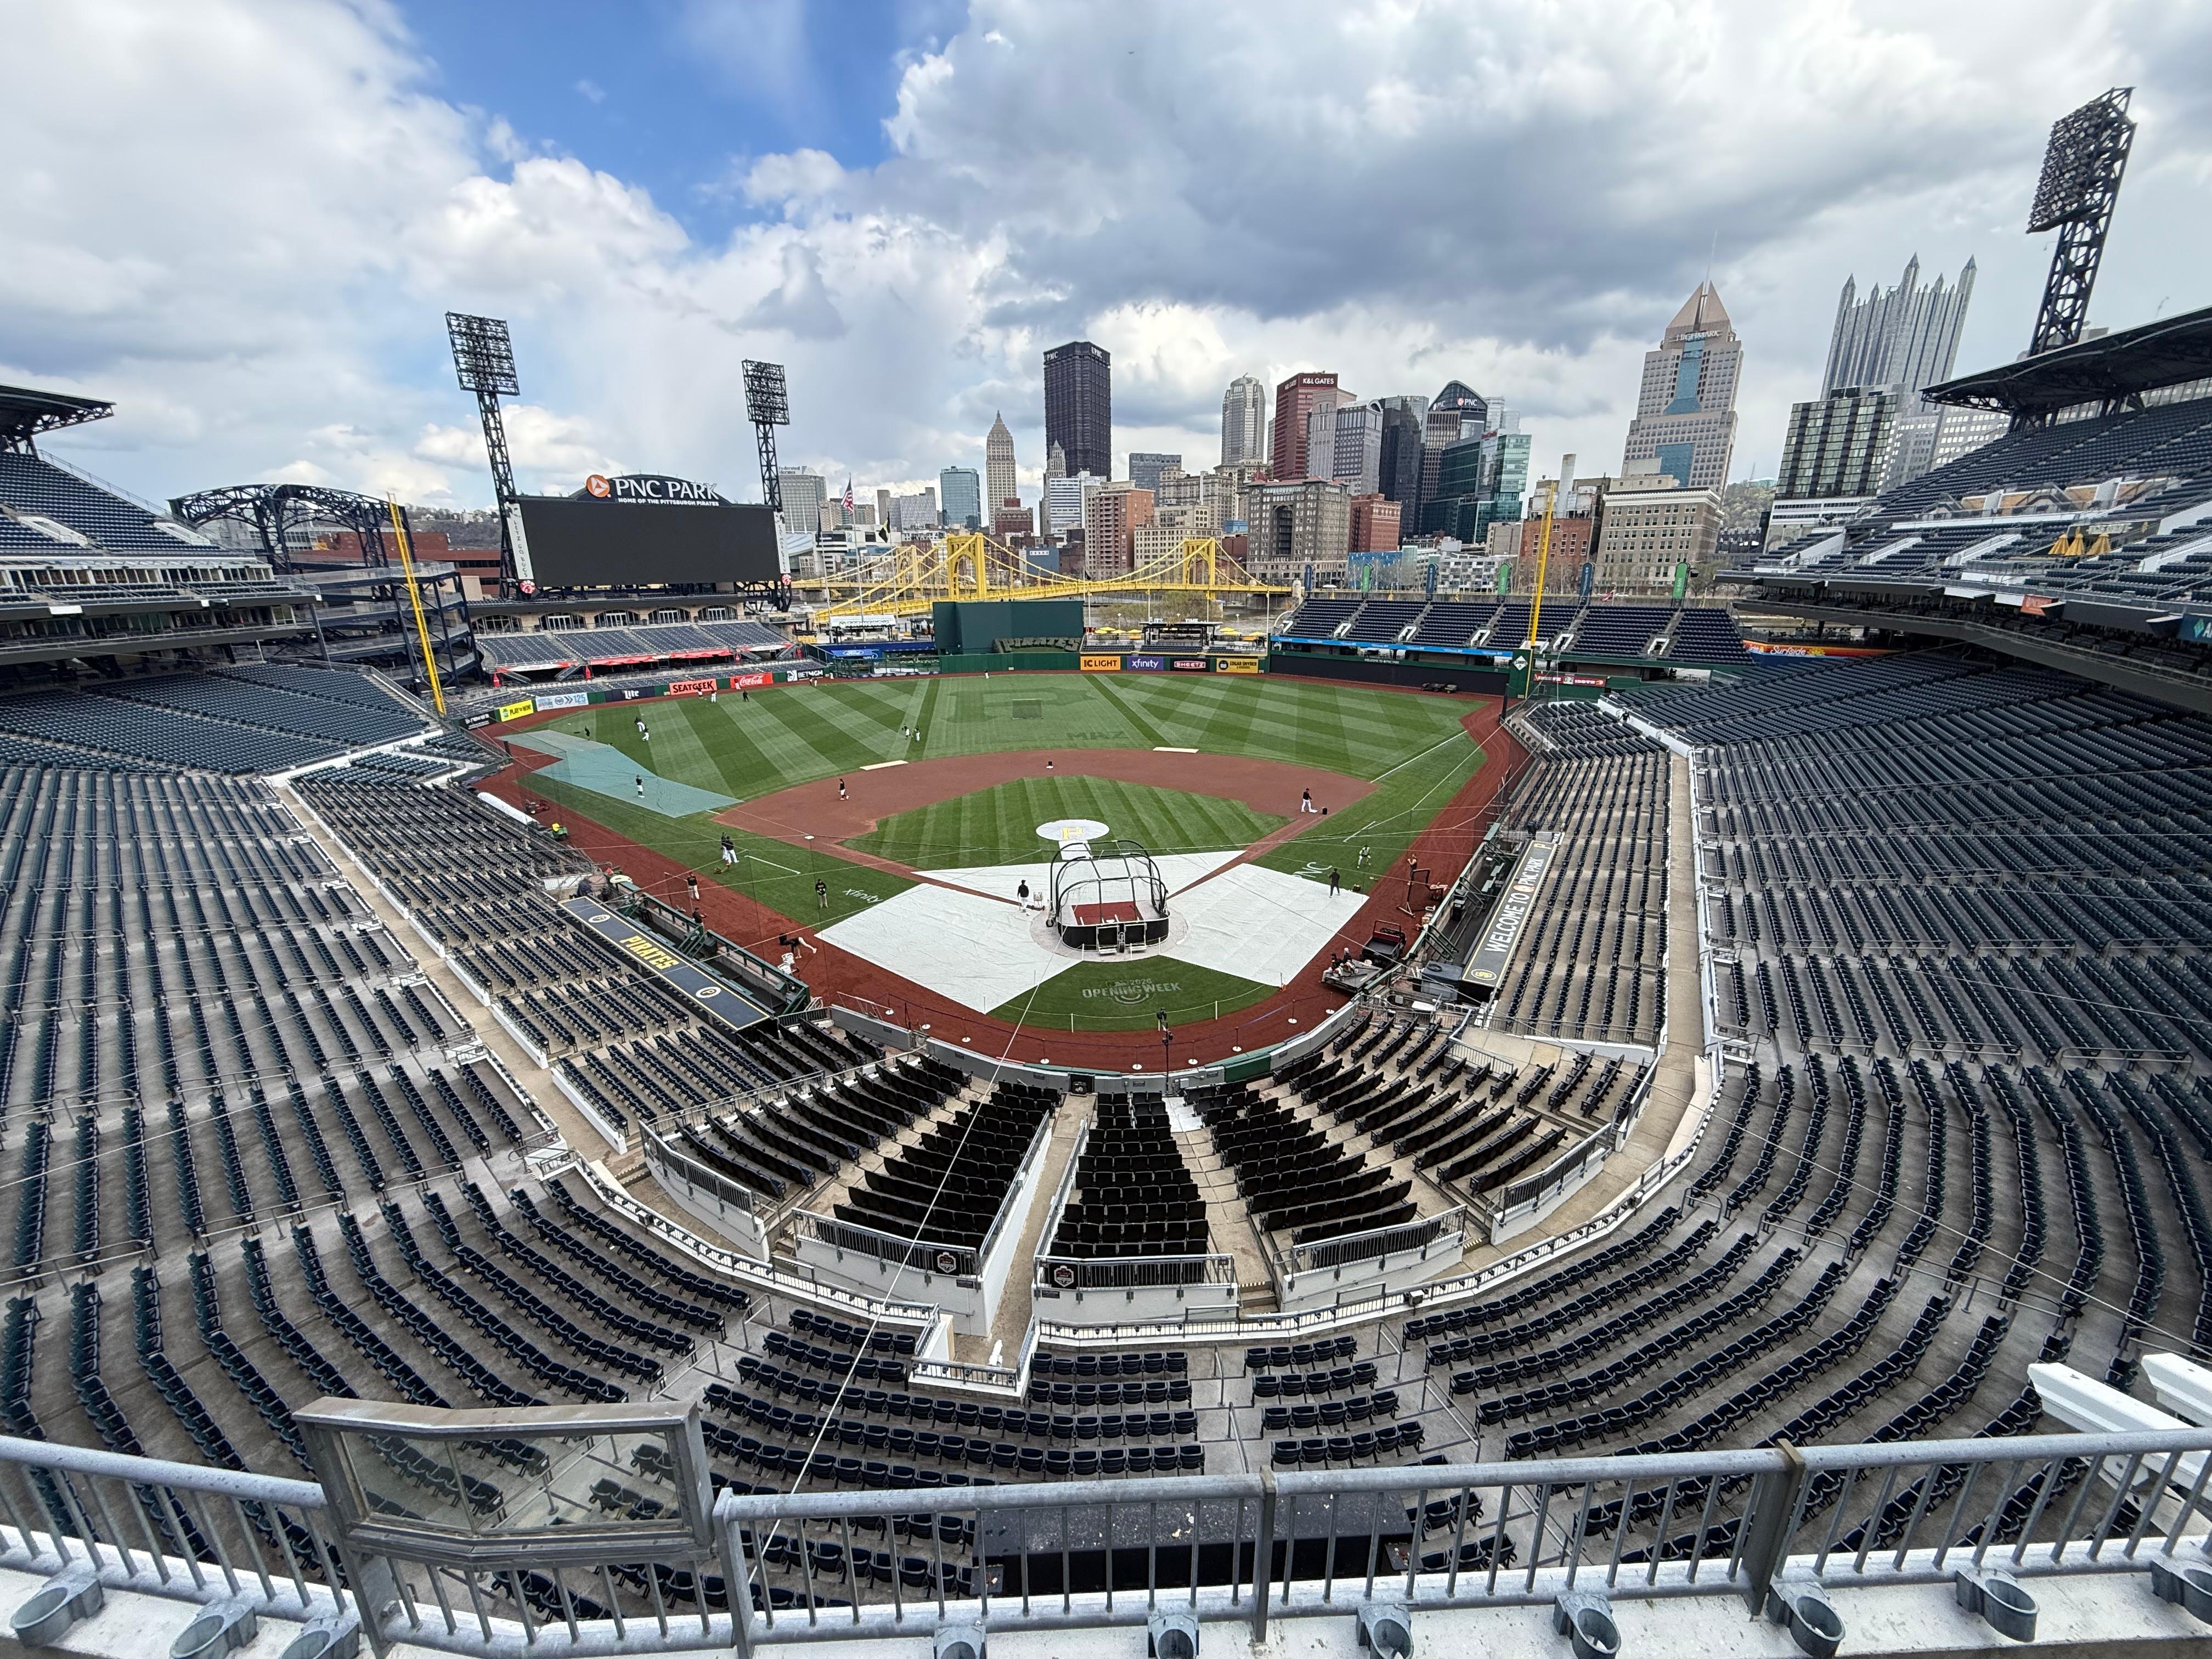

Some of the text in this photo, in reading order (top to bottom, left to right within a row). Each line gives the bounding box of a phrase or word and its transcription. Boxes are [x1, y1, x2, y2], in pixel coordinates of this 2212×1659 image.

[1677, 330, 1722, 341] HIGHMARK
[1045, 351, 1058, 362] UPMC
[1091, 346, 1103, 359] UPMC
[1437, 400, 1446, 408] PNC
[1464, 398, 1477, 407] PNC
[612, 478, 719, 500] PNC PARK
[2202, 622, 2212, 638] A
[1001, 636, 1081, 652] PIRATES
[1770, 645, 1806, 656] Surfside
[1132, 659, 1159, 669] xfinity
[798, 670, 823, 678] BETMGM
[673, 680, 713, 693] SEATGEEK
[573, 694, 586, 703] 125
[623, 690, 639, 699] Lite
[510, 707, 520, 715] PLAY
[843, 888, 884, 903] xfinity
[1485, 856, 1544, 953] WELCOME TO PNC PARK
[619, 935, 680, 970] PIRATES
[1082, 983, 1182, 998] OPENING WEEK
